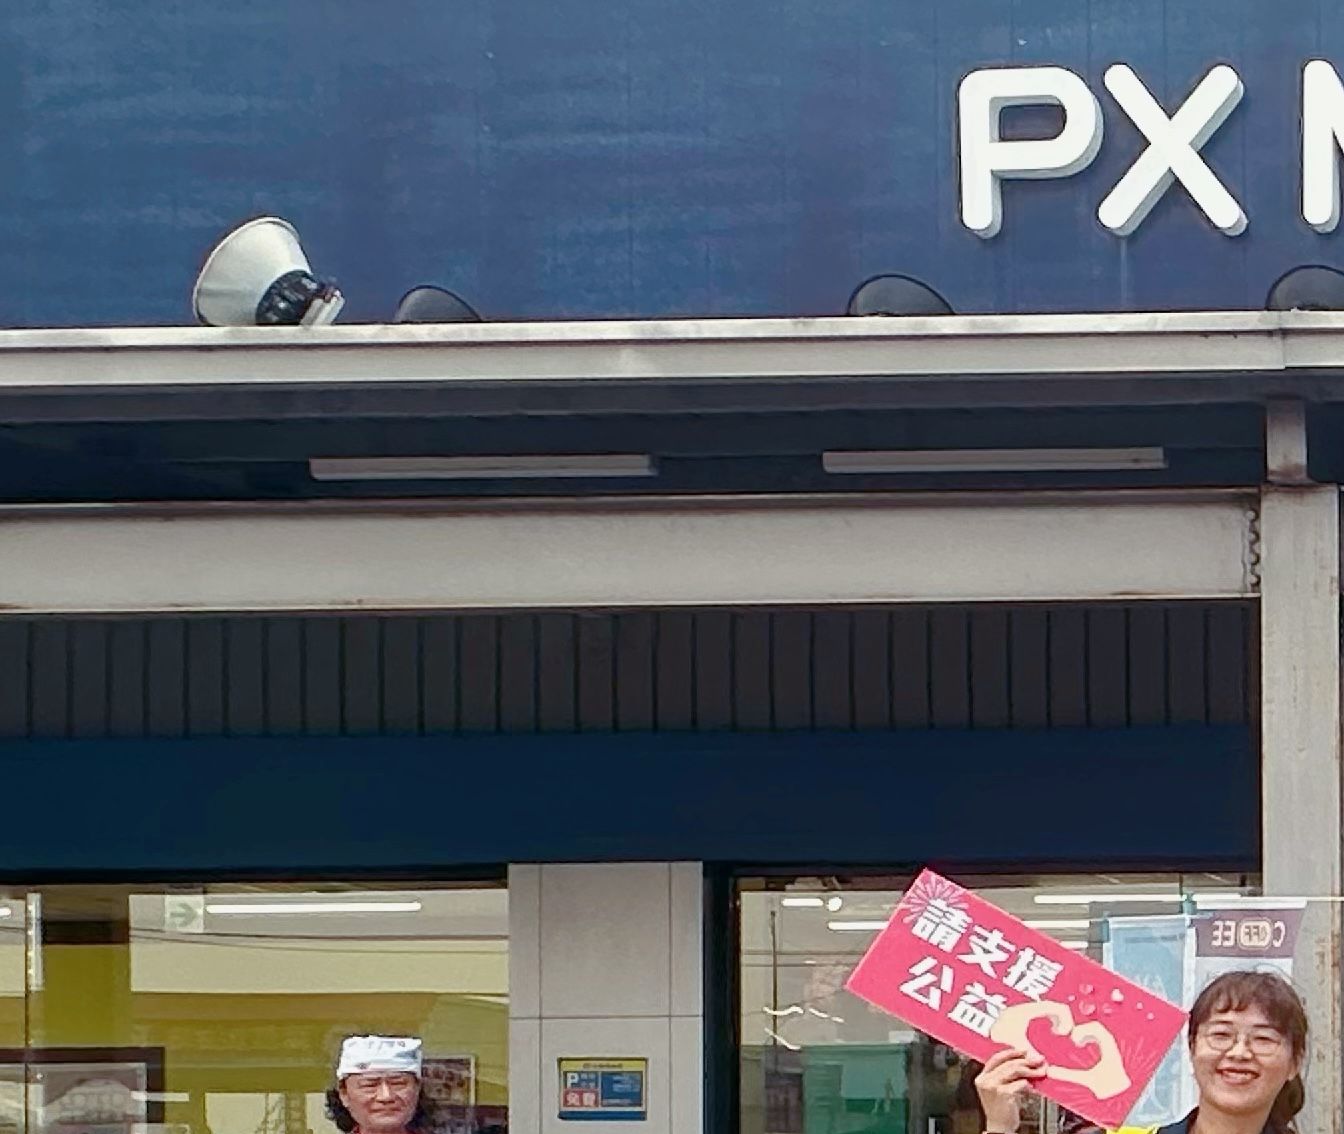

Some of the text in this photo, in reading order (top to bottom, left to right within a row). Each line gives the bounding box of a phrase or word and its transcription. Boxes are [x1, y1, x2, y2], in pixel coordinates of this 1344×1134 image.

[958, 61, 1247, 240] PX
[900, 954, 1008, 1038] 公益
[909, 898, 1065, 1001] 請支援
